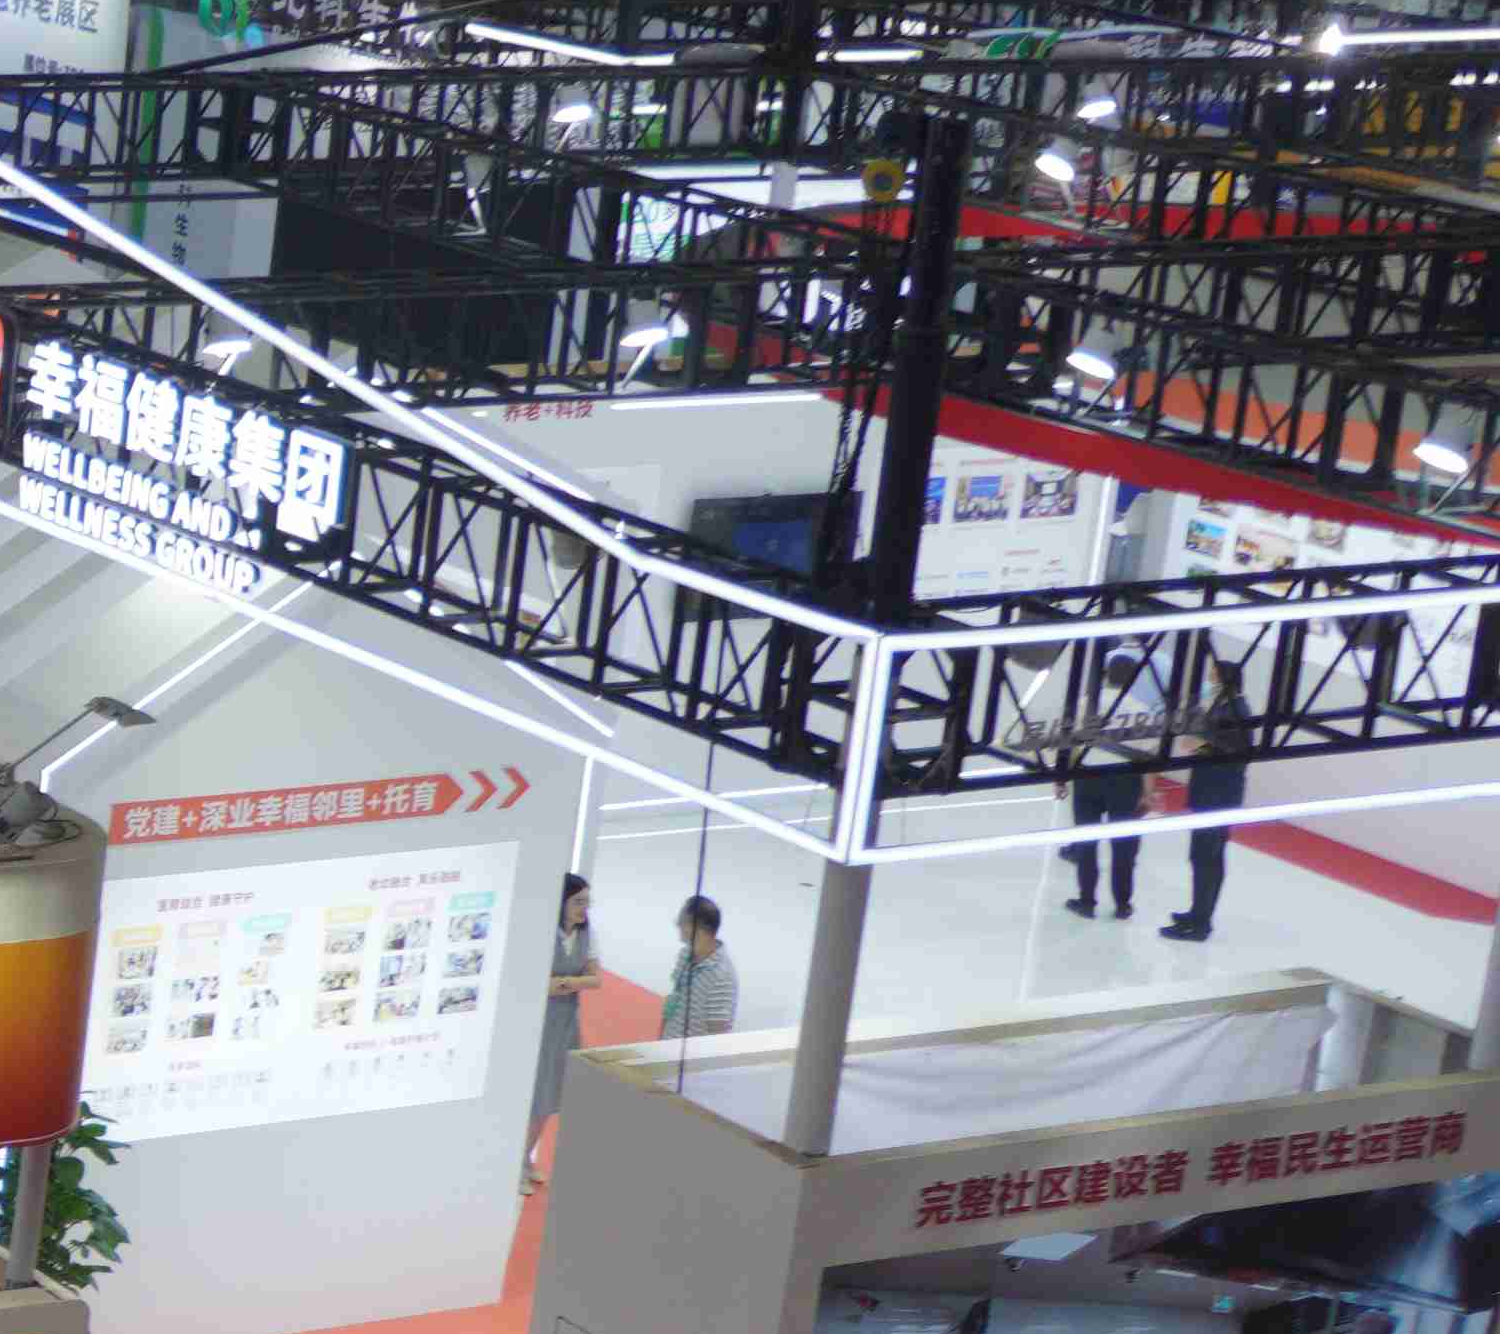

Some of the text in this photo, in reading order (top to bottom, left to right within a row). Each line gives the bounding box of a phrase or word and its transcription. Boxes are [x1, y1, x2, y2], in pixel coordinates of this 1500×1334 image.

[22, 431, 235, 542] WELLBEING AND
[26, 340, 348, 541] 幸福健康集团
[18, 474, 259, 594] WELLNESS GROUP
[123, 779, 438, 839] 党建+深业幸福邻里+托育
[915, 1110, 1468, 1229] 完整社区建设者 幸福民生运营商
